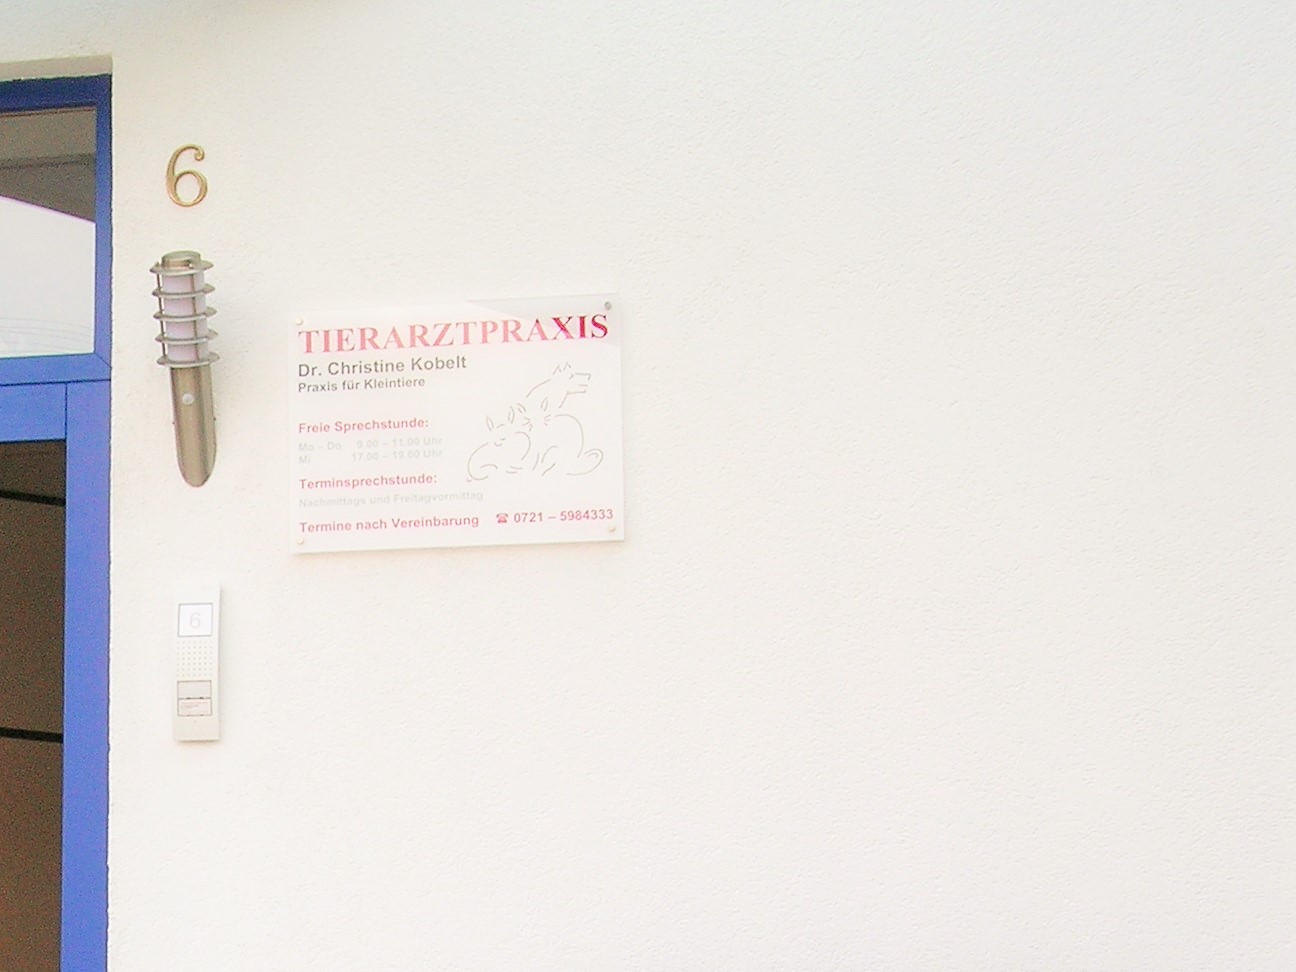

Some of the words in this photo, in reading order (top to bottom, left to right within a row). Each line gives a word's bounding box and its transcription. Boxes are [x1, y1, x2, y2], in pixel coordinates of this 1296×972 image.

[166, 144, 208, 207] 6
[298, 314, 608, 353] TIERARZTPRAXIS
[299, 364, 321, 376] Dr.
[328, 360, 404, 375] Christine
[412, 356, 466, 370] Kobelt
[299, 382, 337, 392] Praxis
[343, 380, 359, 390] für
[365, 378, 425, 389] Kleintiere
[299, 422, 330, 433] Freie
[335, 418, 428, 433] Sprechstunde:
[300, 474, 436, 489] Terminsprechstunde:
[370, 495, 390, 504] und
[394, 492, 483, 503] Freitagvormittag
[514, 512, 542, 523] 0721
[560, 509, 613, 521] 5984333
[300, 521, 351, 532] Termine
[356, 519, 387, 530] nach
[392, 517, 478, 528] Vereinbarung
[189, 611, 201, 630] 6
